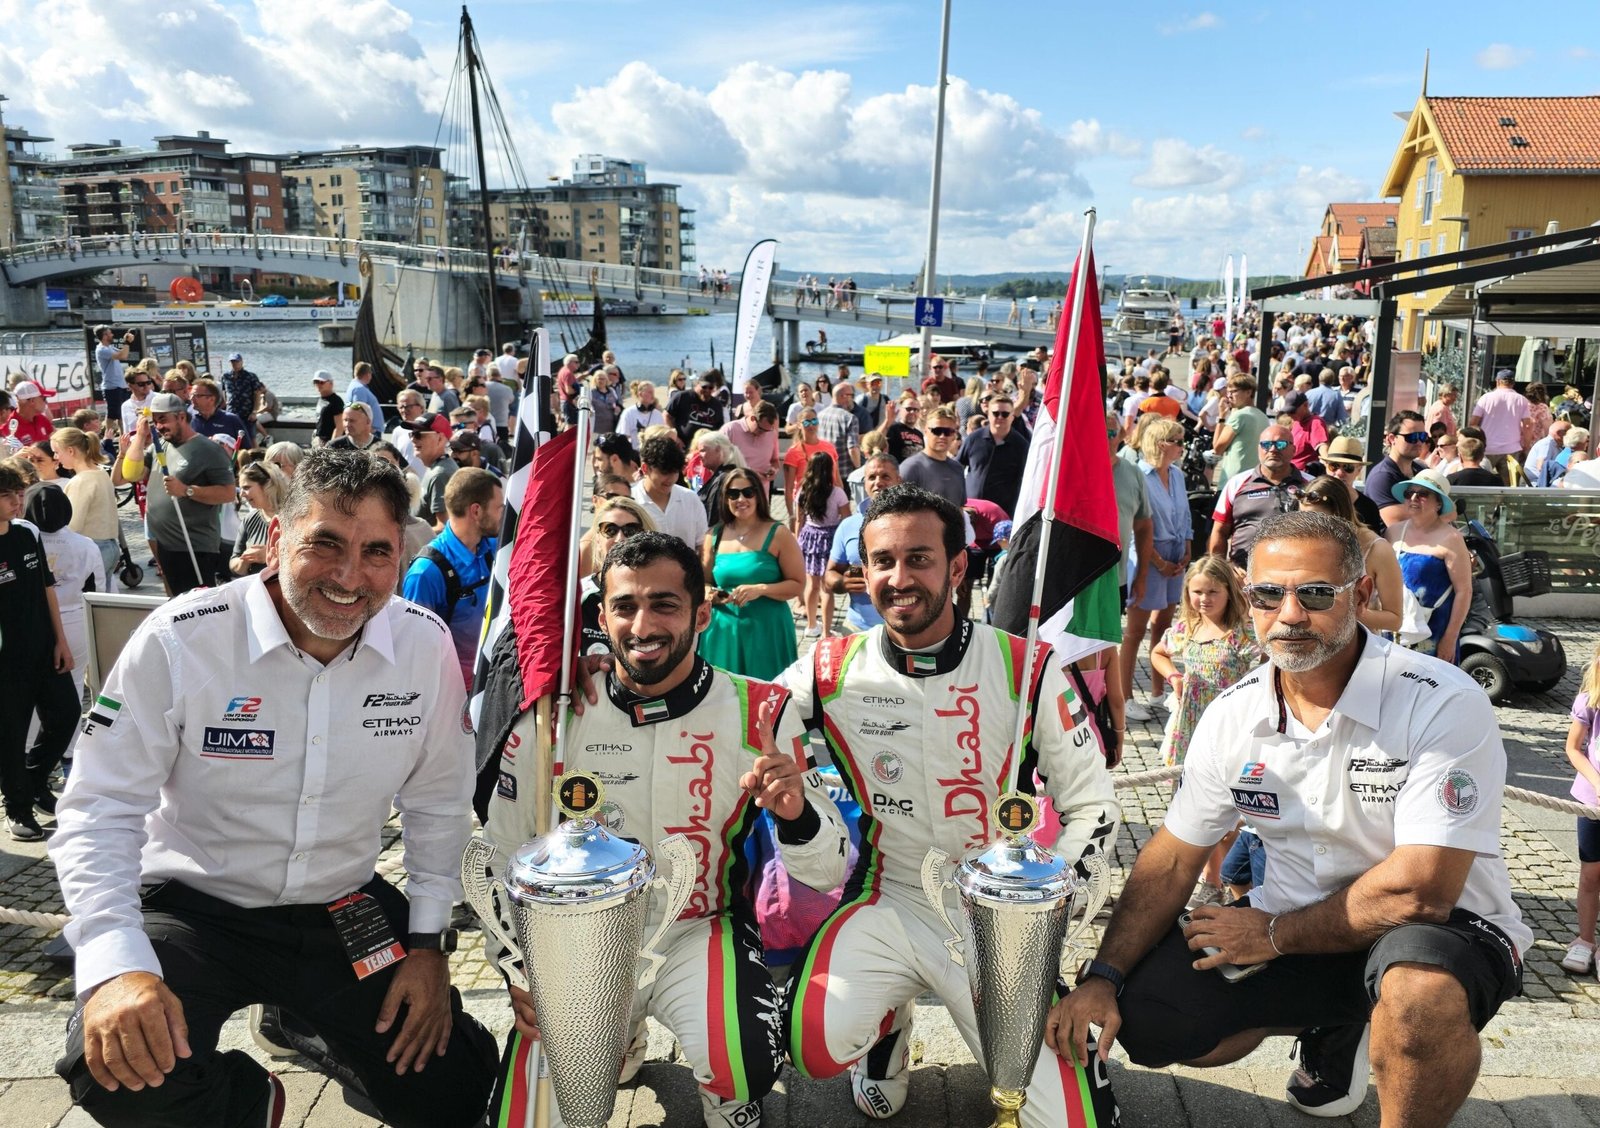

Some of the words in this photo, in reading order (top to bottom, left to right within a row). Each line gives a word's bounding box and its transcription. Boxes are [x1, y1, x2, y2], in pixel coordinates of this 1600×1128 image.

[173, 611, 195, 623] ABU
[197, 604, 230, 617] DHABI
[405, 607, 424, 617] ABU
[1400, 671, 1419, 680] ABU
[1235, 676, 1260, 690] DHABI
[226, 696, 262, 712] F2
[362, 694, 386, 707] F2
[862, 695, 905, 705] ETIHAD
[362, 715, 421, 728] ETIHAD
[207, 731, 247, 747] UIM
[374, 728, 413, 737] AIRWAYS
[585, 743, 633, 752] ETIHAD
[1241, 762, 1266, 776] F2
[1347, 758, 1367, 772] F2
[873, 793, 913, 812] DAC
[1233, 791, 1259, 807] UIM
[874, 806, 914, 818] RACING
[362, 947, 396, 973] TEAM
[866, 1086, 890, 1115] OMP
[734, 1102, 761, 1127] OM
